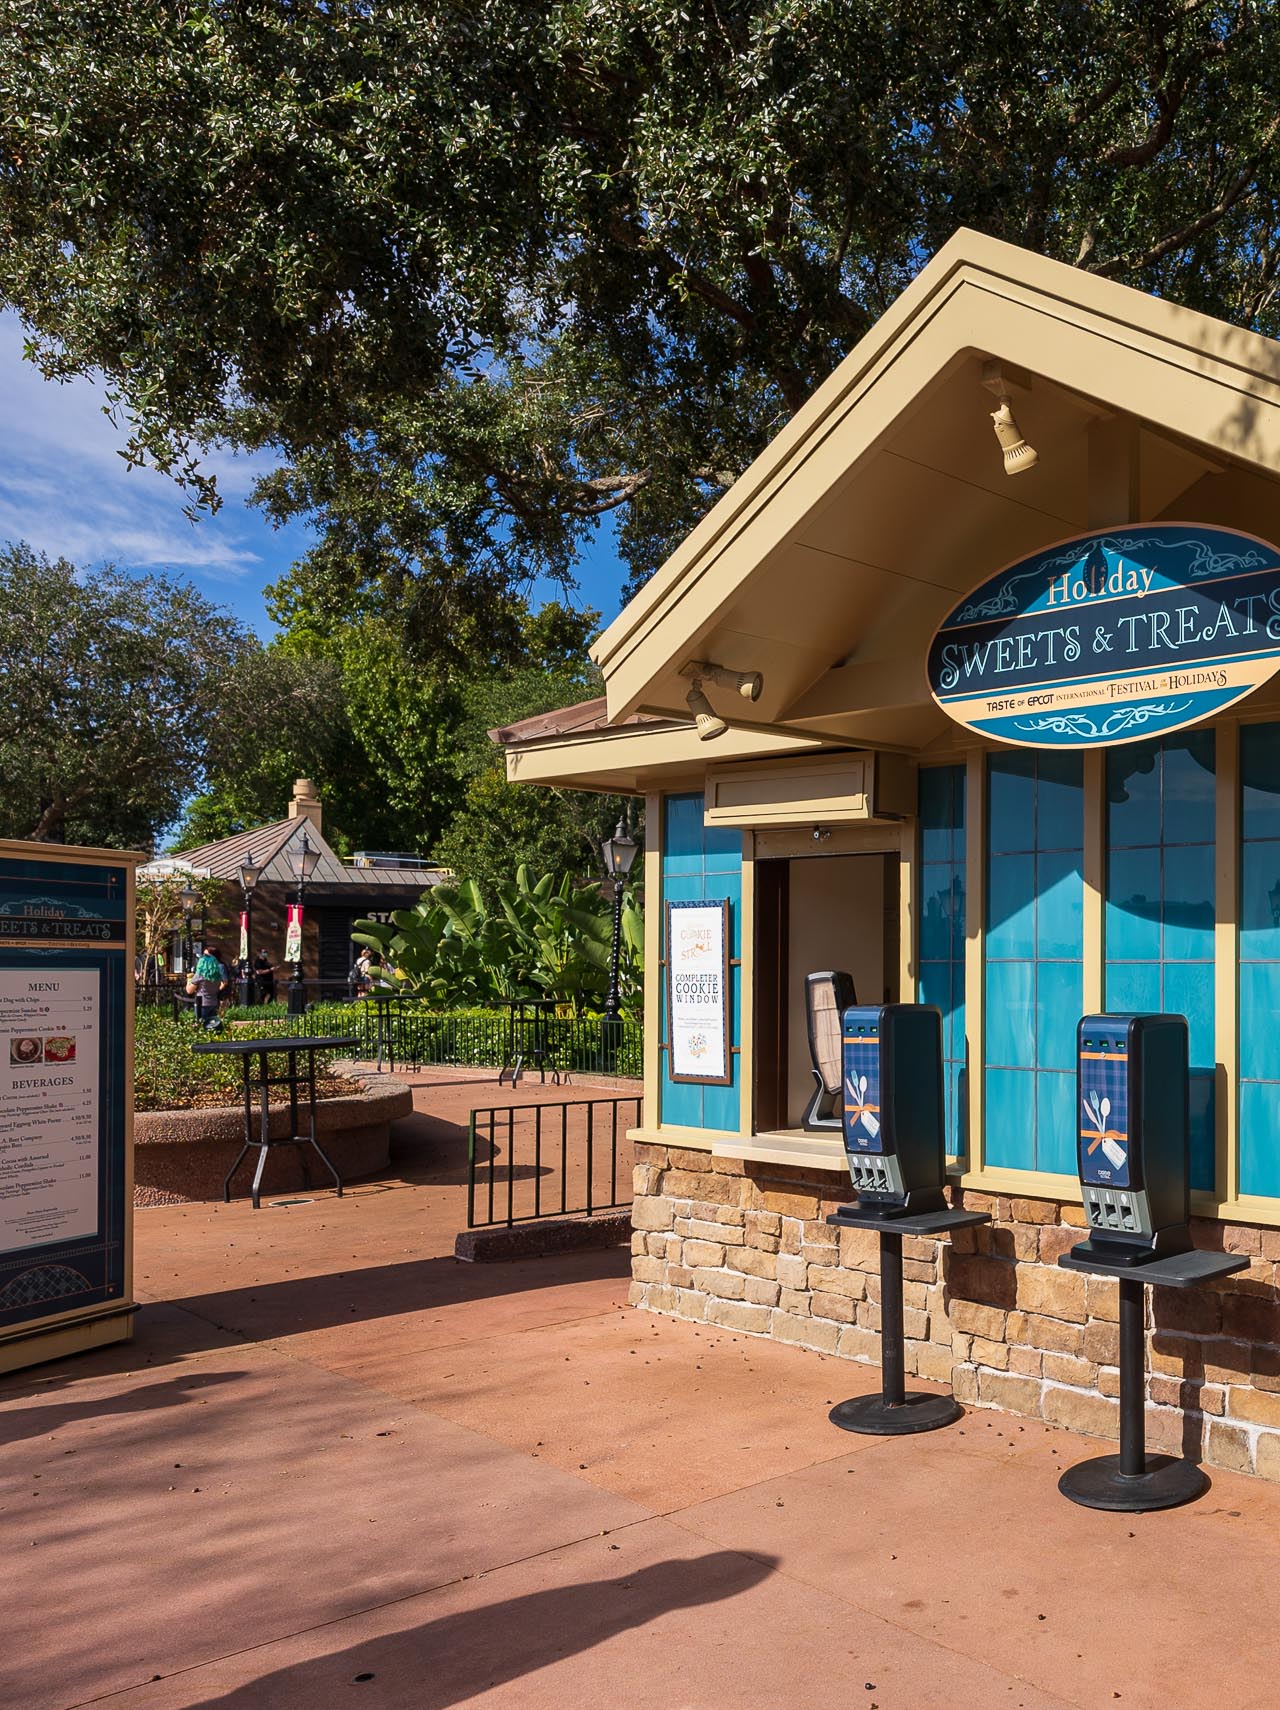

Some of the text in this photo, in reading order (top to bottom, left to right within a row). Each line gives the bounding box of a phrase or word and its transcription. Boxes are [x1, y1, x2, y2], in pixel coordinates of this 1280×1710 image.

[1046, 562, 1158, 606] Holiday
[939, 625, 1081, 690] SWEETS
[1092, 626, 1113, 654] &
[987, 699, 1016, 712] TASTE
[1027, 694, 1055, 707] EPCOT
[1056, 689, 1105, 701] INTERNATIONAL
[1106, 679, 1158, 698] FESTIVAL
[1169, 670, 1227, 690] HOLIDAYS
[24, 905, 66, 919] Holiday
[42, 924, 50, 933] &
[51, 922, 111, 939] TREATS
[675, 974, 718, 983] COMPLETER
[28, 982, 60, 992] MENU
[675, 983, 719, 994] COOKIE
[676, 995, 719, 1004] WINDOW
[12, 1077, 74, 1089] BEVERAGES
